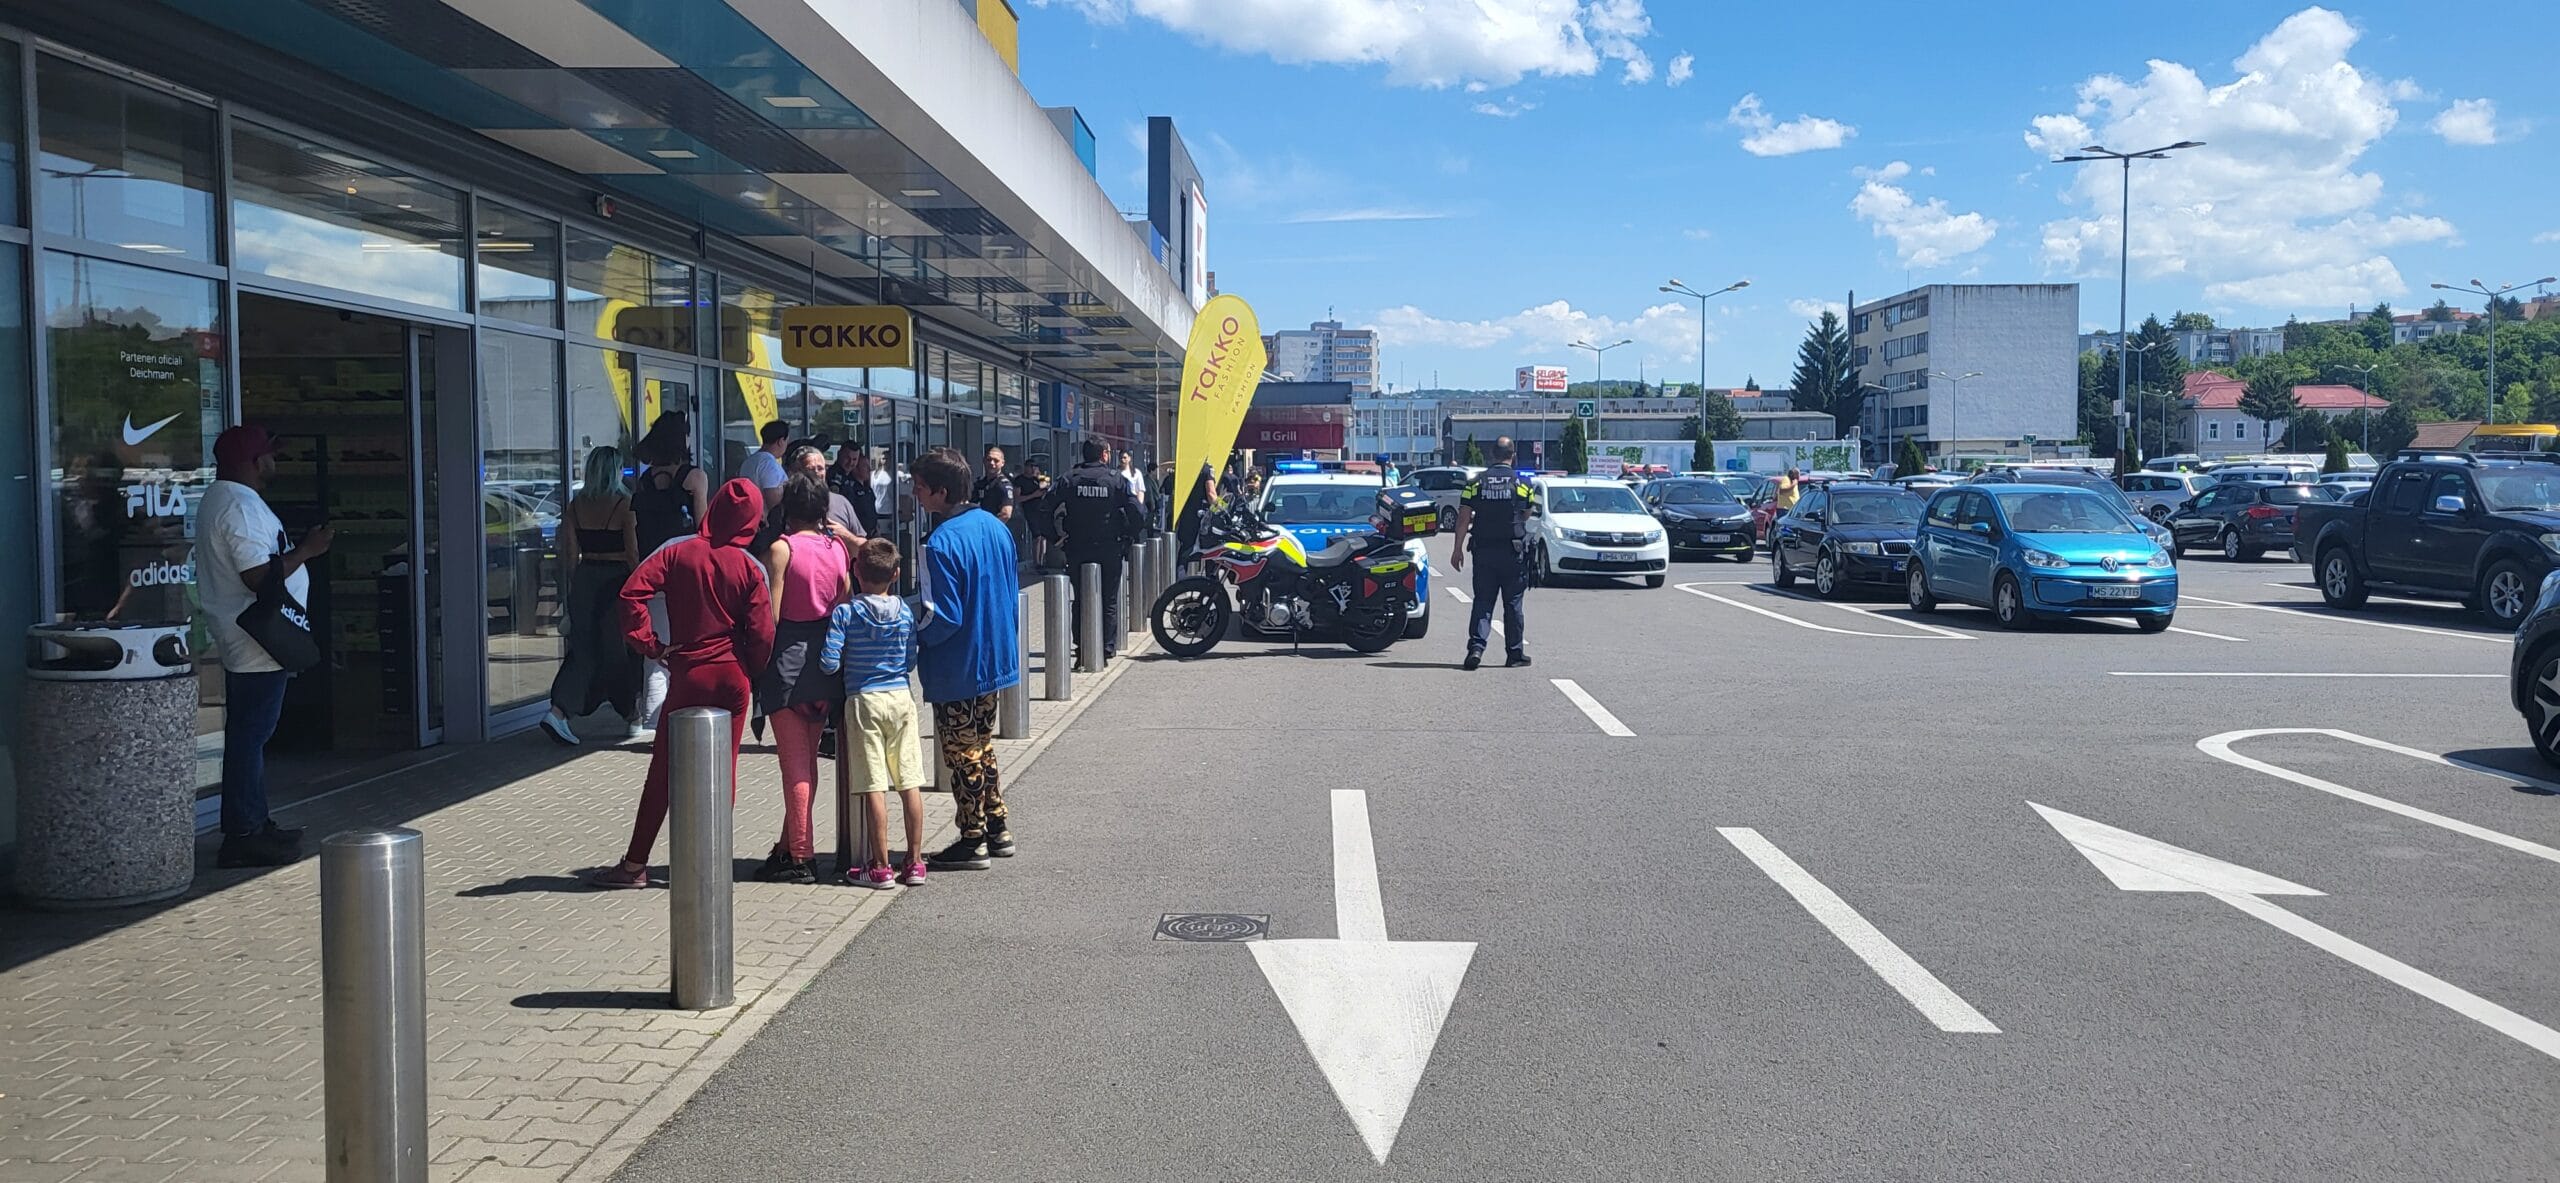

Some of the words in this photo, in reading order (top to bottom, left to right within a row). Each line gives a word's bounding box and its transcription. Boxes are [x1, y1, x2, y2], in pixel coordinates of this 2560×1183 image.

[130, 367, 175, 380] Deichmann
[1215, 337, 1246, 399] FASHION
[1272, 431, 1297, 442] Grill
[126, 484, 187, 518] FILA
[130, 561, 190, 587] adidas
